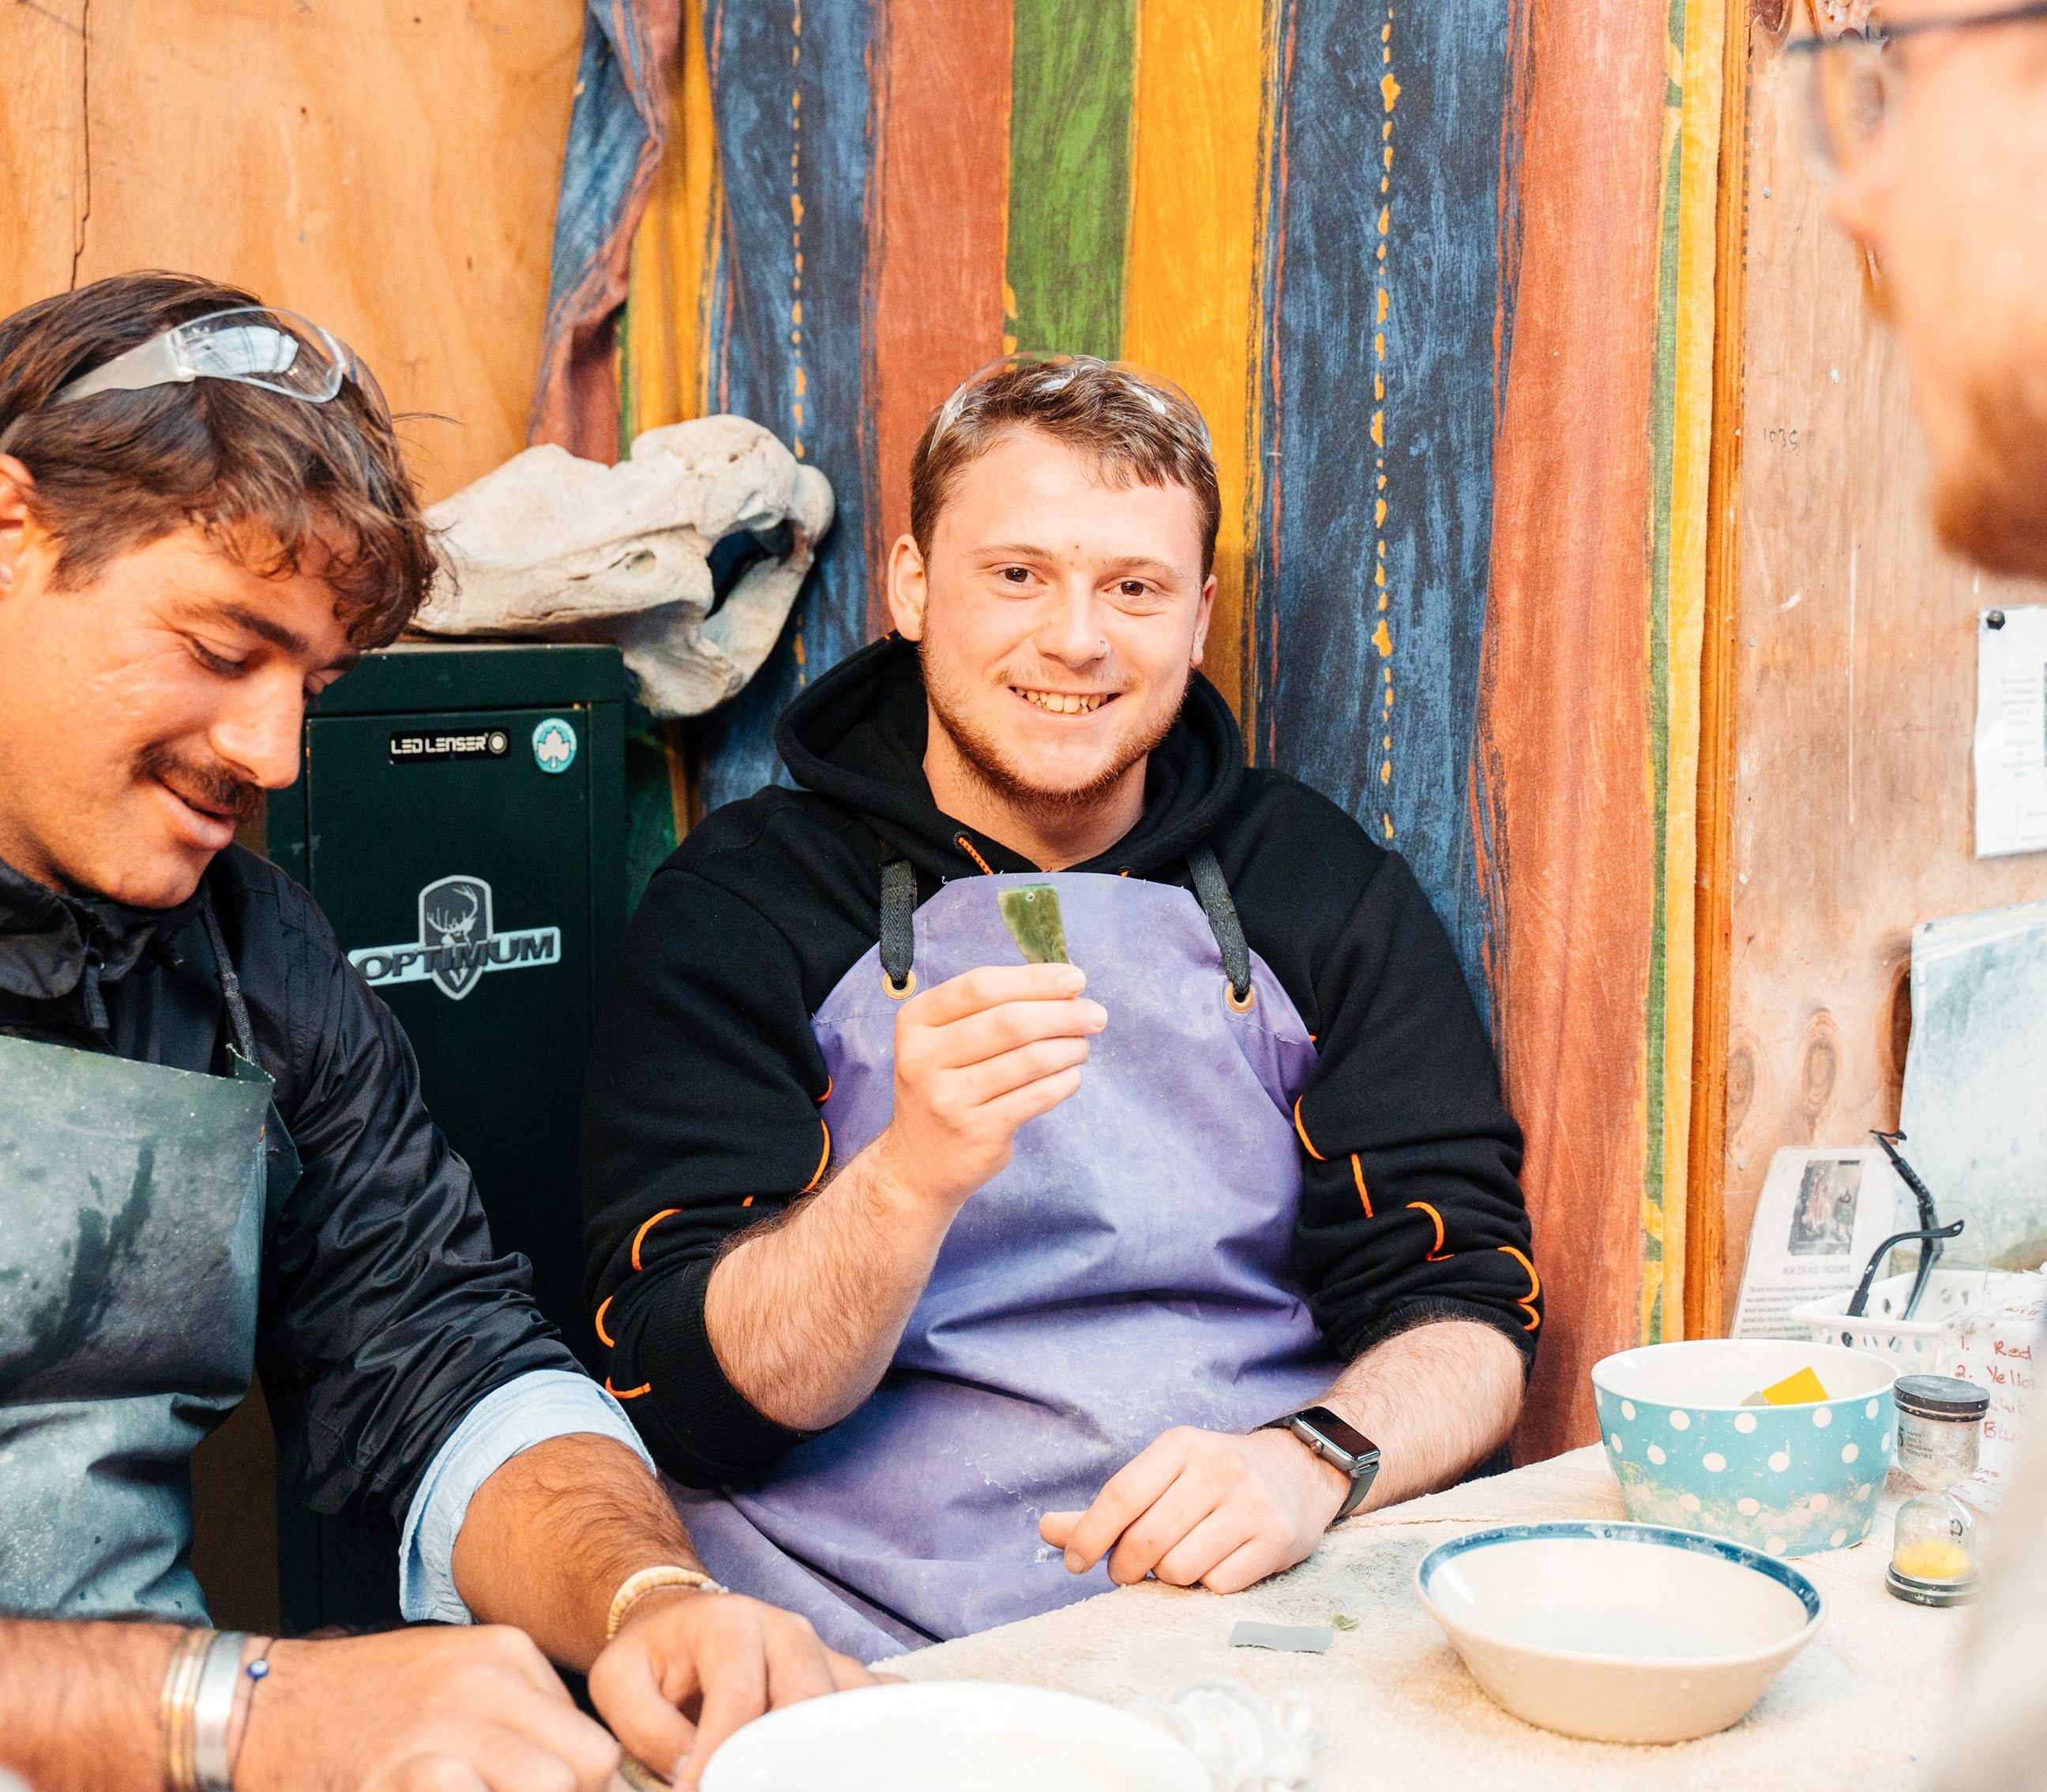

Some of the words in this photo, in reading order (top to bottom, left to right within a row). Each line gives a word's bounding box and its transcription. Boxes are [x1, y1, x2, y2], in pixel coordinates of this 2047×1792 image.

[391, 738, 423, 754] LED
[356, 933, 554, 981] OPTIMUM
[1994, 1340, 2032, 1360] Red
[1955, 1364, 1973, 1379] 2.
